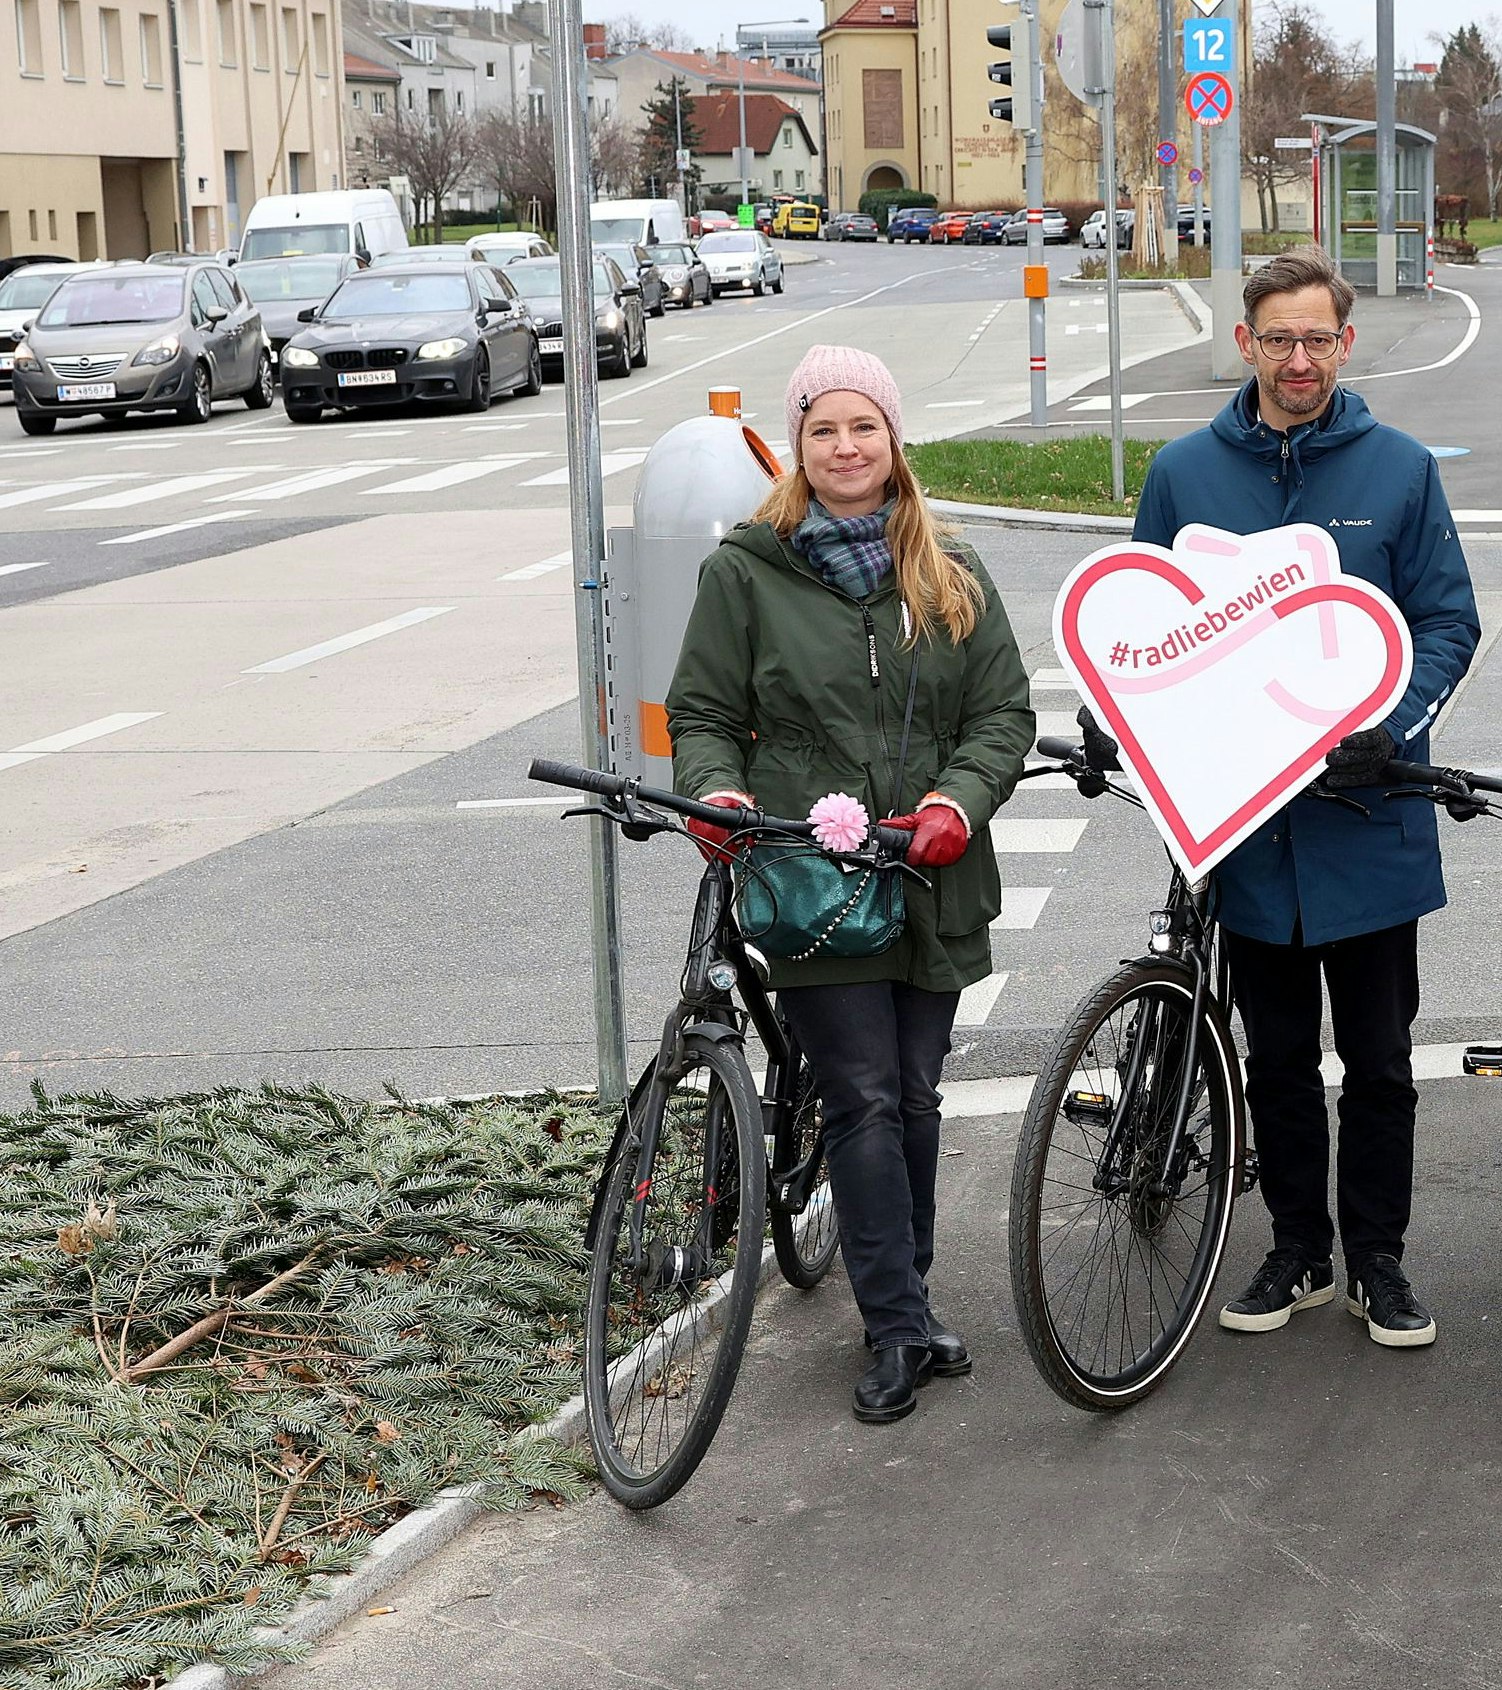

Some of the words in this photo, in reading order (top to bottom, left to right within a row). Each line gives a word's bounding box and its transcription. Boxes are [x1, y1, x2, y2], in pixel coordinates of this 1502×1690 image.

[1192, 28, 1225, 61] 12
[1342, 519, 1373, 527] VAUDE
[1109, 563, 1306, 669] #radliebewien
